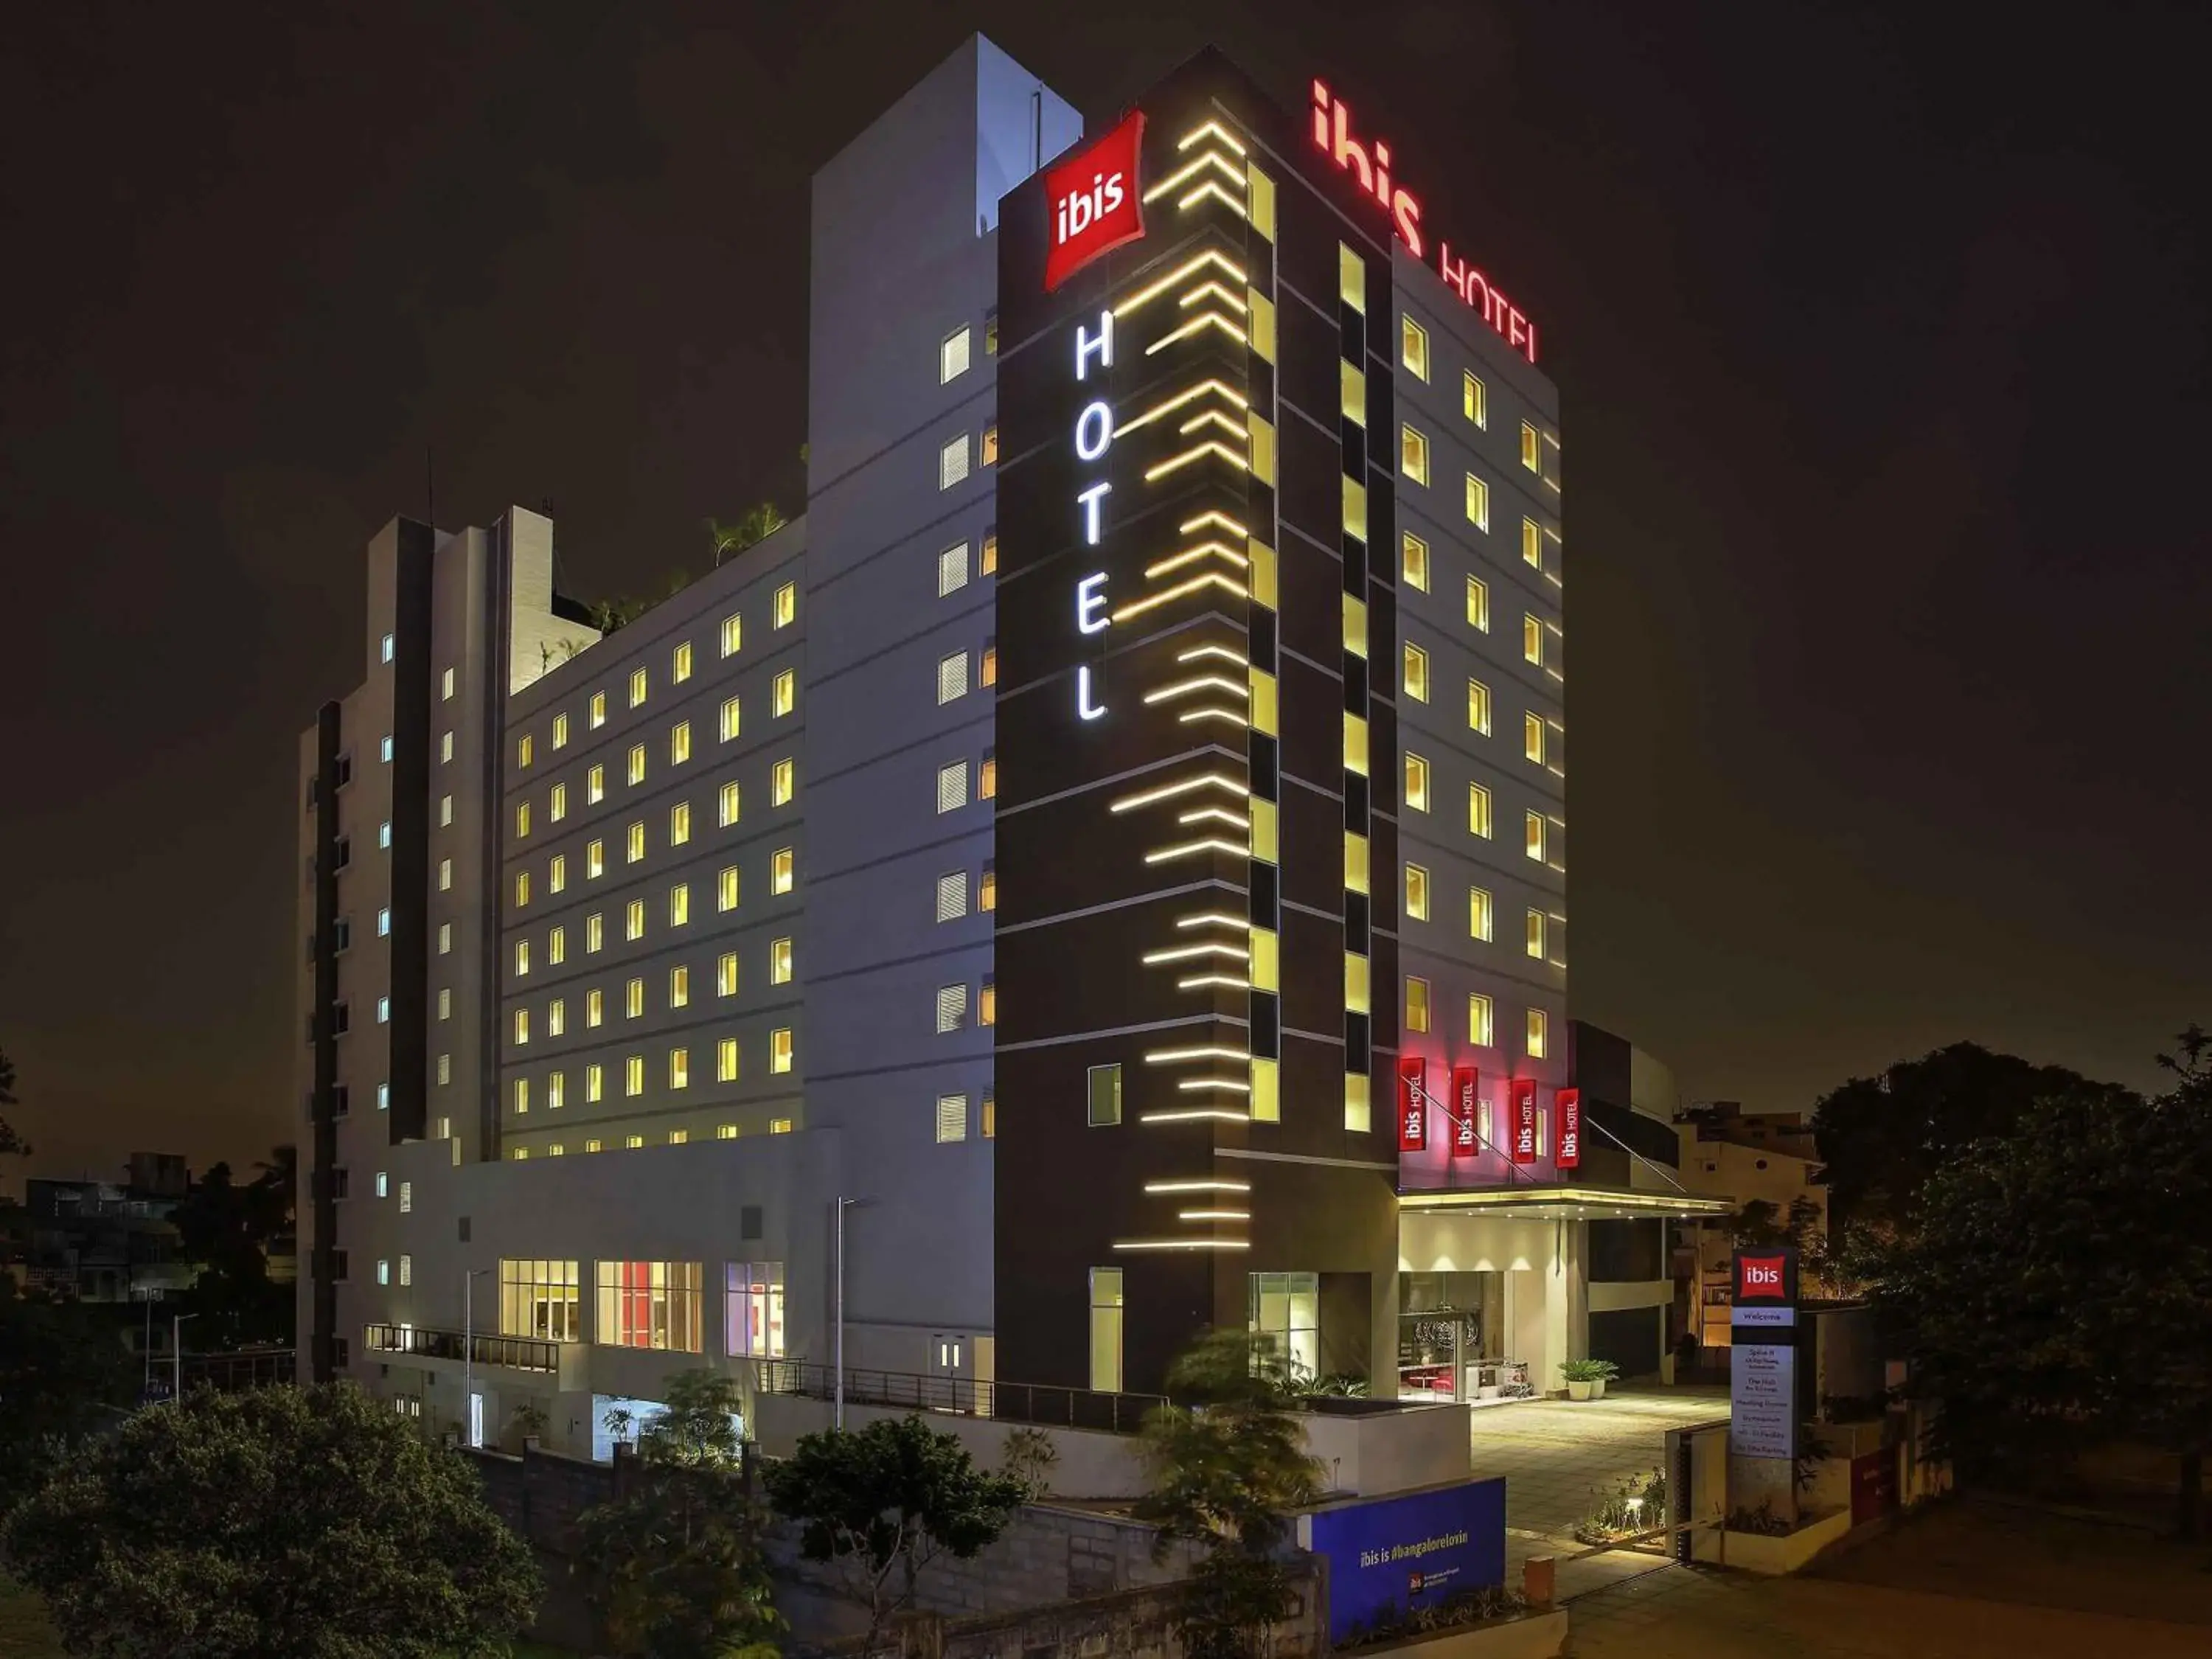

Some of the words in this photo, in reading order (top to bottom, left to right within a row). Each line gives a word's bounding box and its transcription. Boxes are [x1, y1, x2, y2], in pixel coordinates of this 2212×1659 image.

[1057, 172, 1123, 244] ibis
[1075, 310, 1113, 721] HOTEL
[1411, 1074, 1421, 1107] HOTEL
[1462, 1082, 1473, 1115] HOTEL
[1523, 1093, 1532, 1125] HOTEL
[1568, 1101, 1579, 1130] HOTEL
[1405, 1112, 1421, 1139] ibis
[1458, 1117, 1472, 1145] ibis
[1517, 1127, 1532, 1153] ibis
[1562, 1132, 1576, 1158] ibis
[1747, 1267, 1778, 1284] ibis
[1360, 1549, 1380, 1568] ibis
[1381, 1548, 1390, 1563] is
